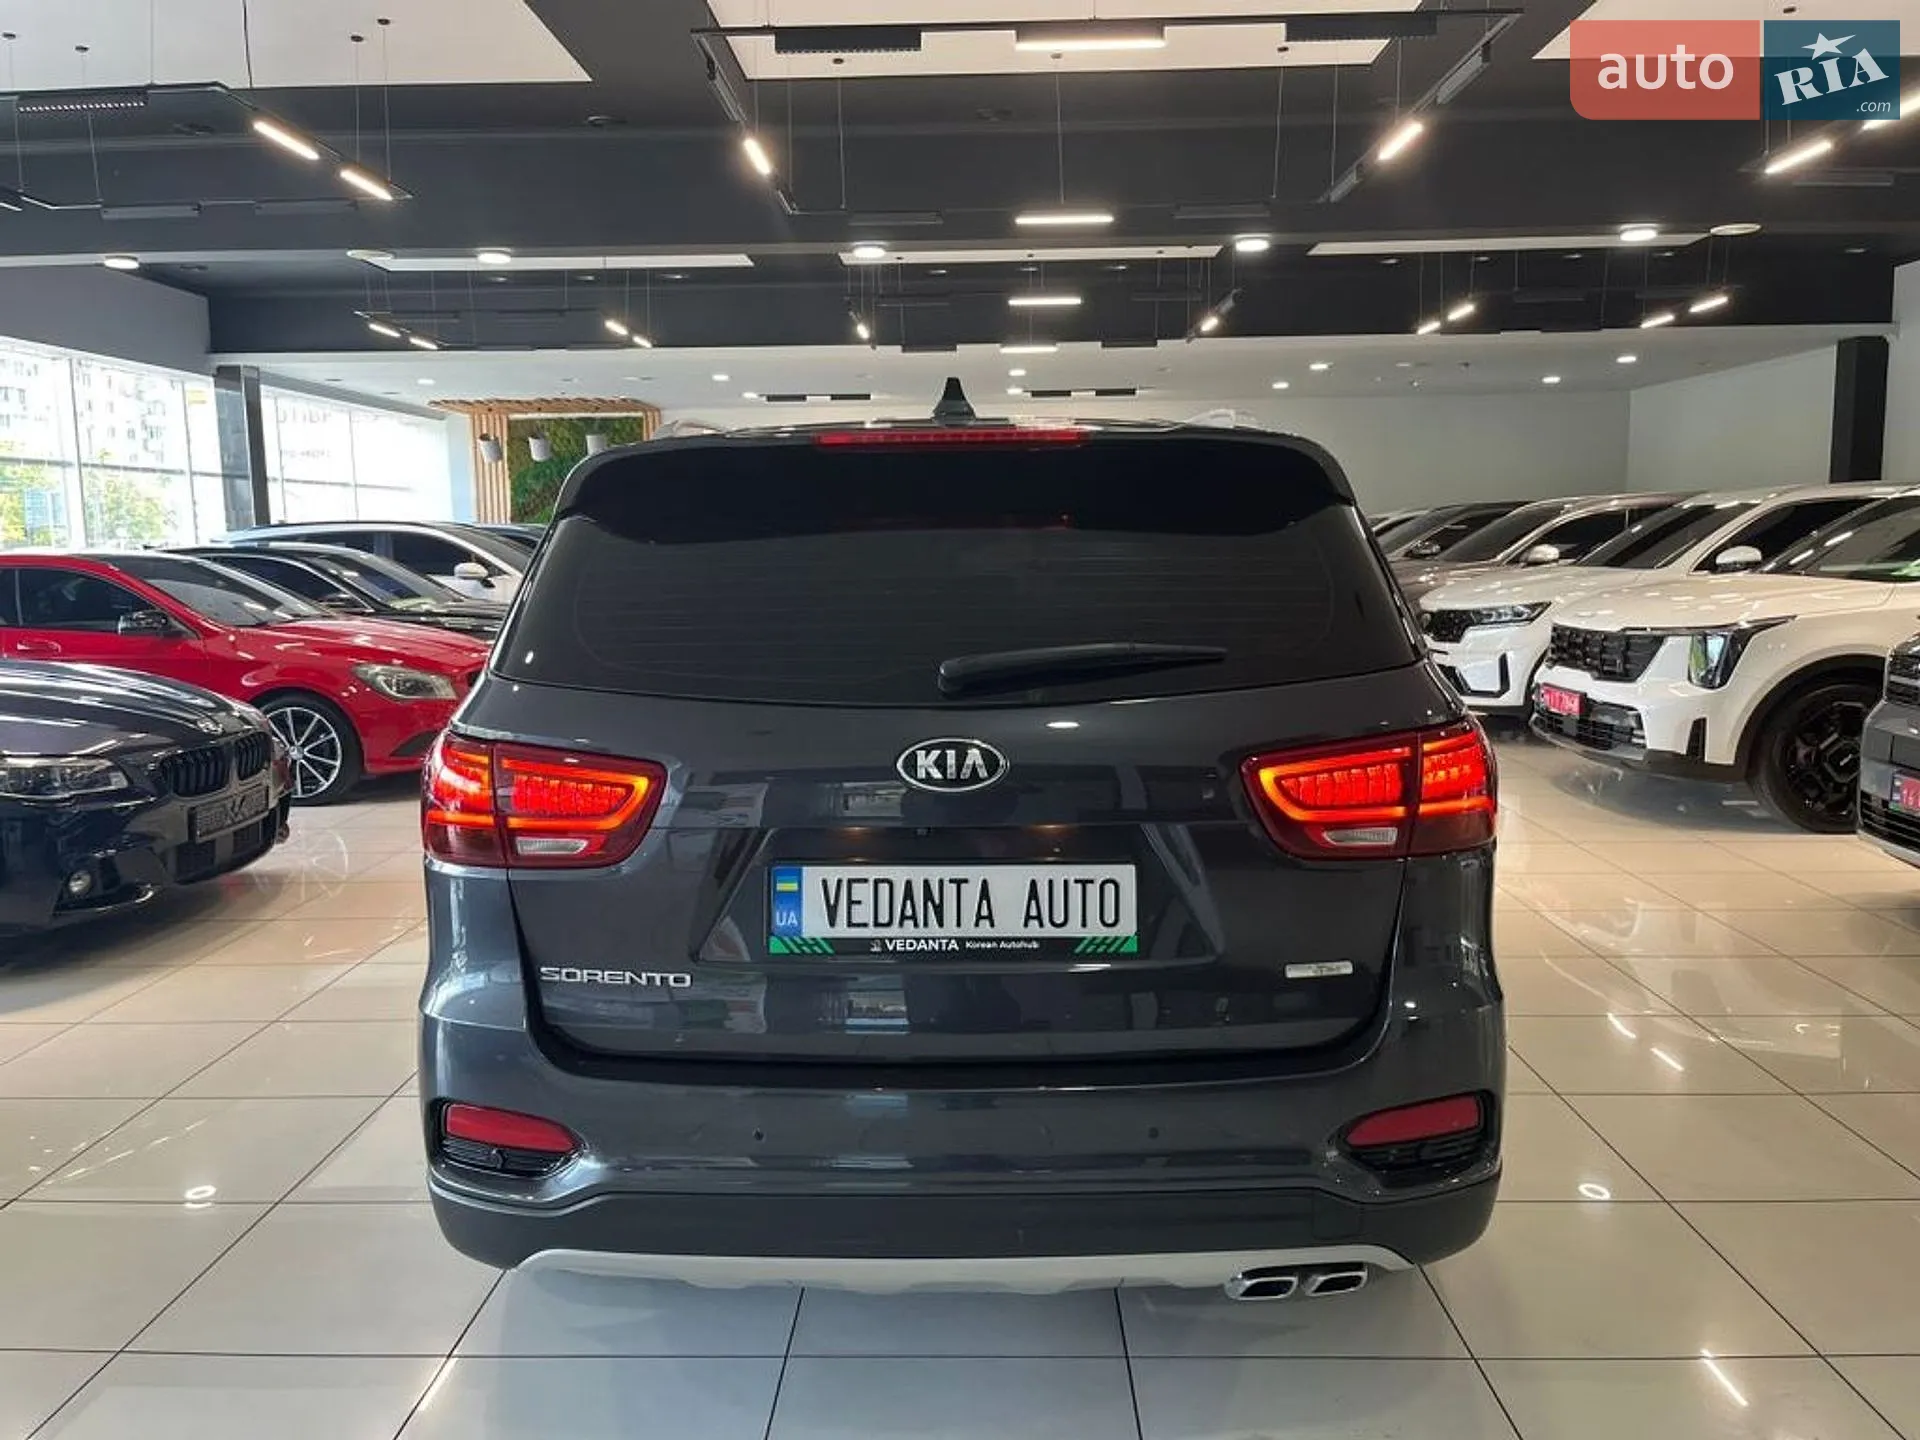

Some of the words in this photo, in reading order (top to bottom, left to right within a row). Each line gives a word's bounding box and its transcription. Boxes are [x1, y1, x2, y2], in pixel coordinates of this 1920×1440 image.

[915, 747, 989, 780] KIA
[820, 877, 995, 929] VEDANTA
[1023, 877, 1121, 929] AUTO
[775, 910, 799, 928] UA
[885, 939, 959, 952] VEDANTA
[965, 941, 998, 950] Korean
[999, 941, 1039, 950] Autohub
[539, 967, 692, 988] SORENTO
